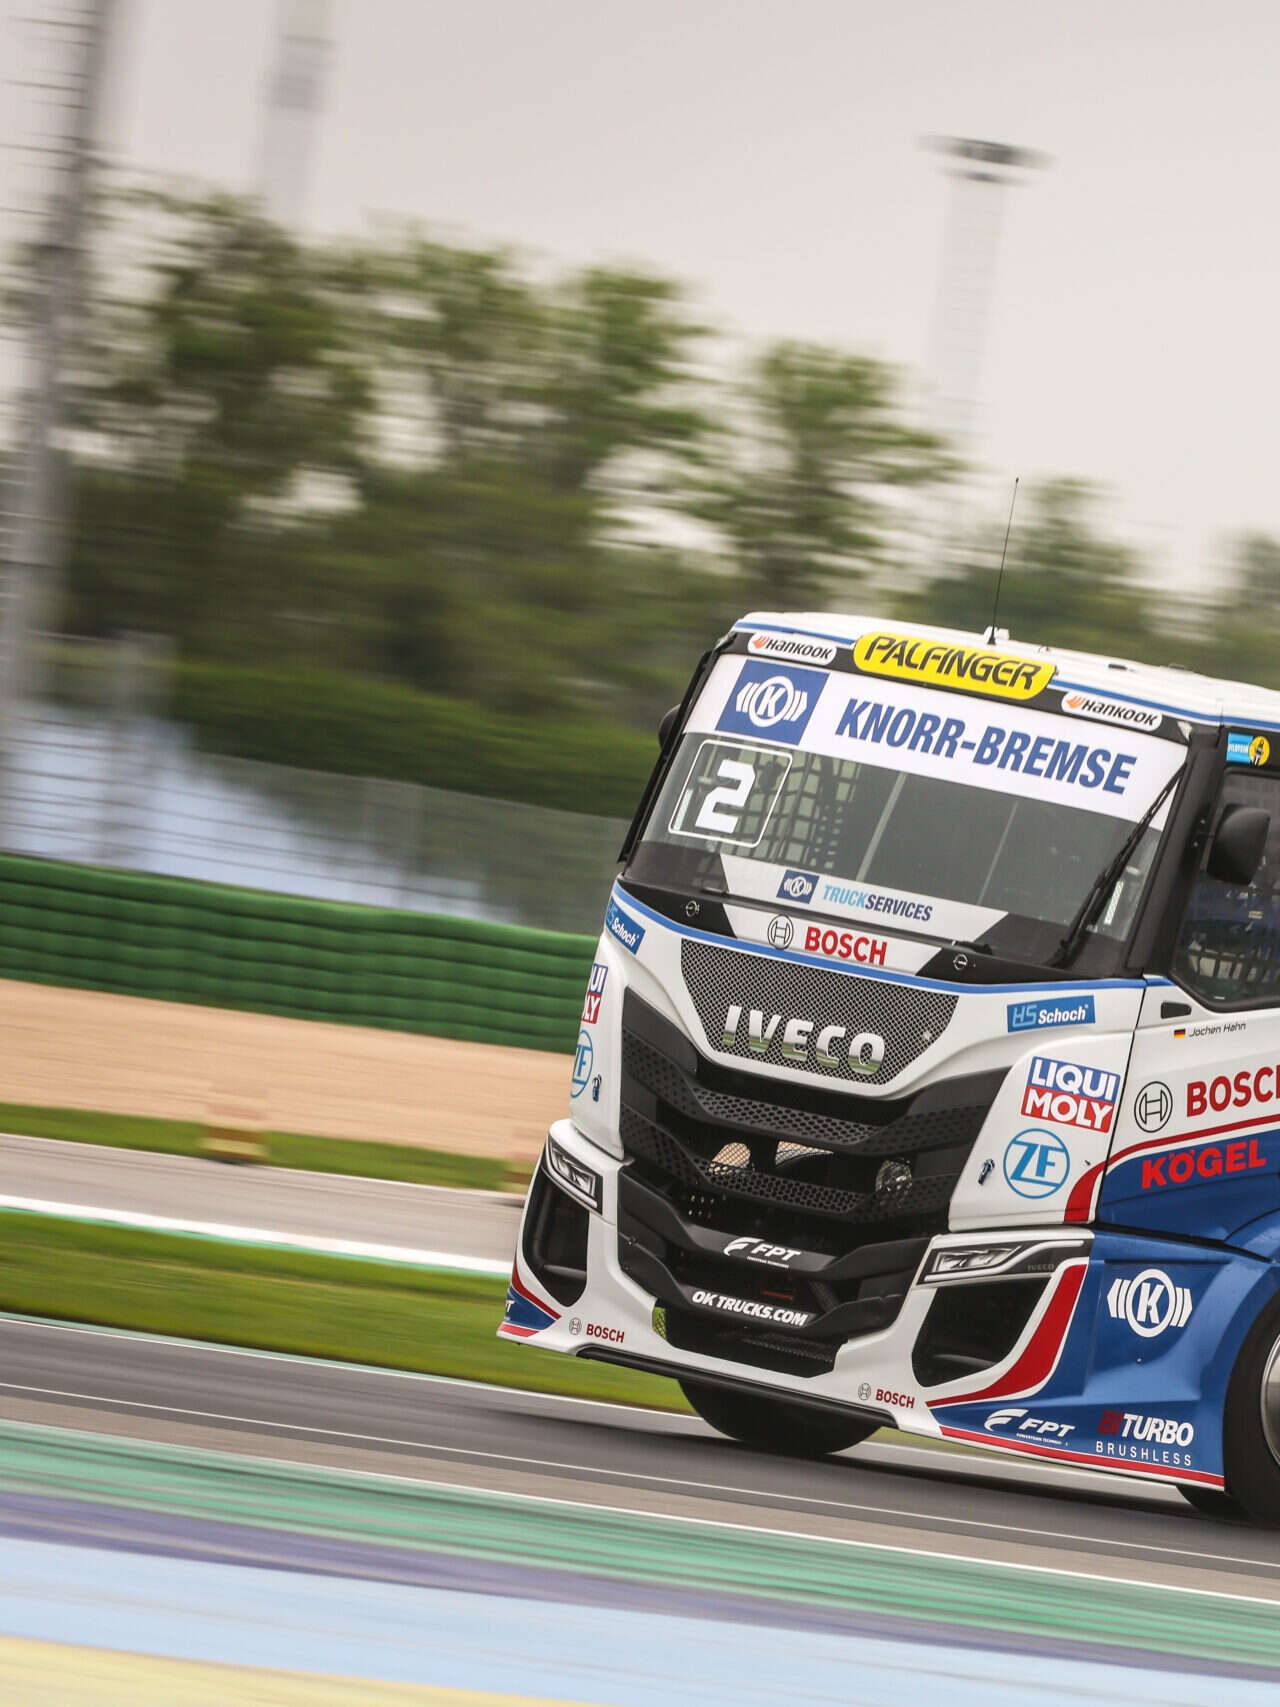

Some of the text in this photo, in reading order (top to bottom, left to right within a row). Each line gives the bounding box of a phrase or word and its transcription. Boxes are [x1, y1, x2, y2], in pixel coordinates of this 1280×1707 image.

[864, 636, 1041, 690] PALFINGER
[835, 698, 1138, 794] KNORR-BREMSE
[695, 759, 755, 834] 2
[804, 926, 888, 966] BOSCH
[1038, 1005, 1087, 1025] Schoch
[1189, 1025, 1221, 1037] Jochen
[722, 1005, 885, 1075] IVECO
[1031, 1058, 1119, 1098] LIQUI
[1025, 1089, 1113, 1131] MOLY
[1142, 1139, 1267, 1189] KÖGEL
[750, 1243, 801, 1261] FPT
[692, 1291, 808, 1327] OK TRUCKS.COM
[586, 1323, 625, 1343] BOSCH
[875, 1389, 915, 1409] BOSCH
[1019, 1418, 1075, 1437] FPT
[1096, 1440, 1191, 1466] BRUSHLESS
